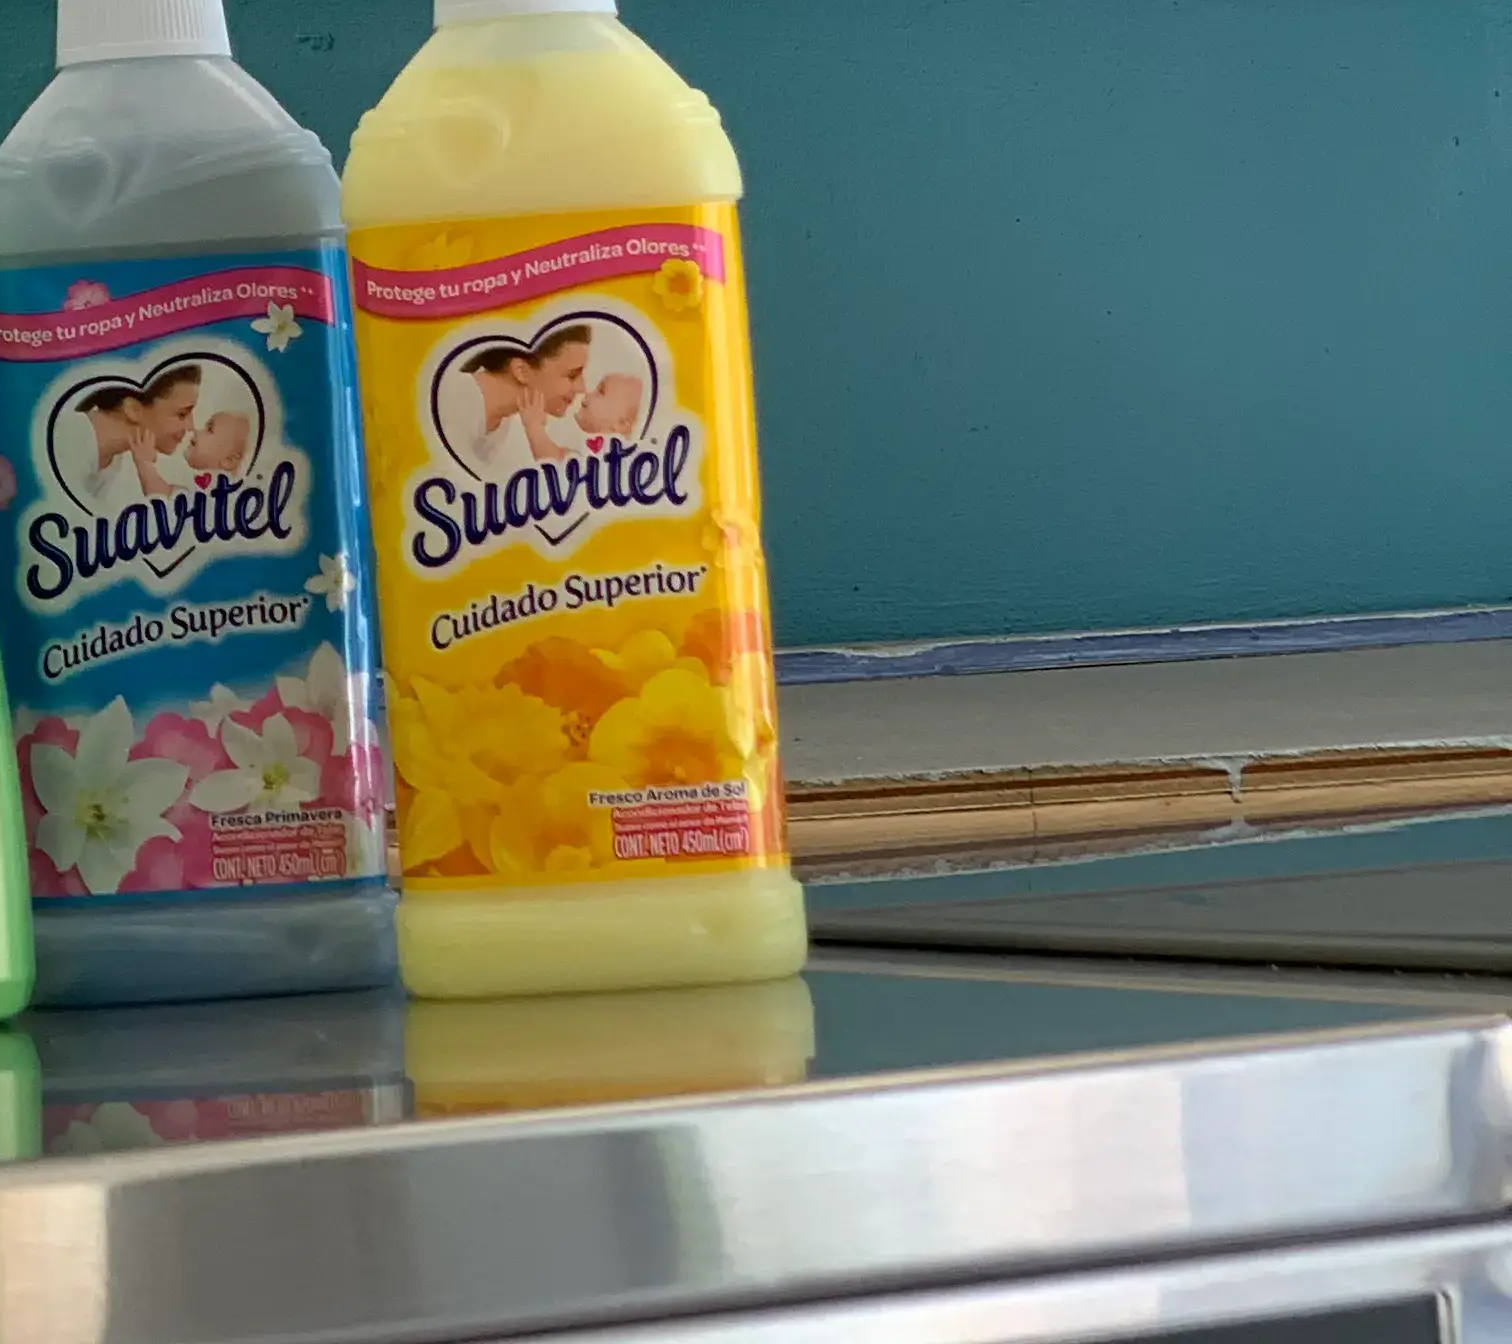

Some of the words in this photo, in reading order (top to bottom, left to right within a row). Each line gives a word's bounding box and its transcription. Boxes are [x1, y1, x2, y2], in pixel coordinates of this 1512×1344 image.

[366, 279, 436, 306] Protege
[438, 284, 460, 300] tu
[462, 274, 509, 296] ropa
[511, 268, 523, 287] y
[524, 243, 624, 278] Neutraliza
[625, 238, 690, 257] Olores
[56, 324, 76, 341] tu
[79, 317, 122, 338] ropa
[124, 310, 137, 330] y
[138, 284, 234, 322] Neutraliza
[236, 283, 299, 301] Olores
[411, 424, 691, 568] Suavitel
[26, 460, 296, 600] Suavitel
[42, 615, 165, 680] Cuidado
[430, 584, 559, 651] Cuidado
[211, 814, 263, 828] Fresca
[265, 809, 343, 824] Primavera
[588, 791, 643, 805] Fresco
[646, 787, 699, 801] Aroma
[701, 784, 720, 798] de
[722, 781, 745, 796] Sol
[246, 854, 276, 878] NETO
[649, 831, 680, 857] NETO
